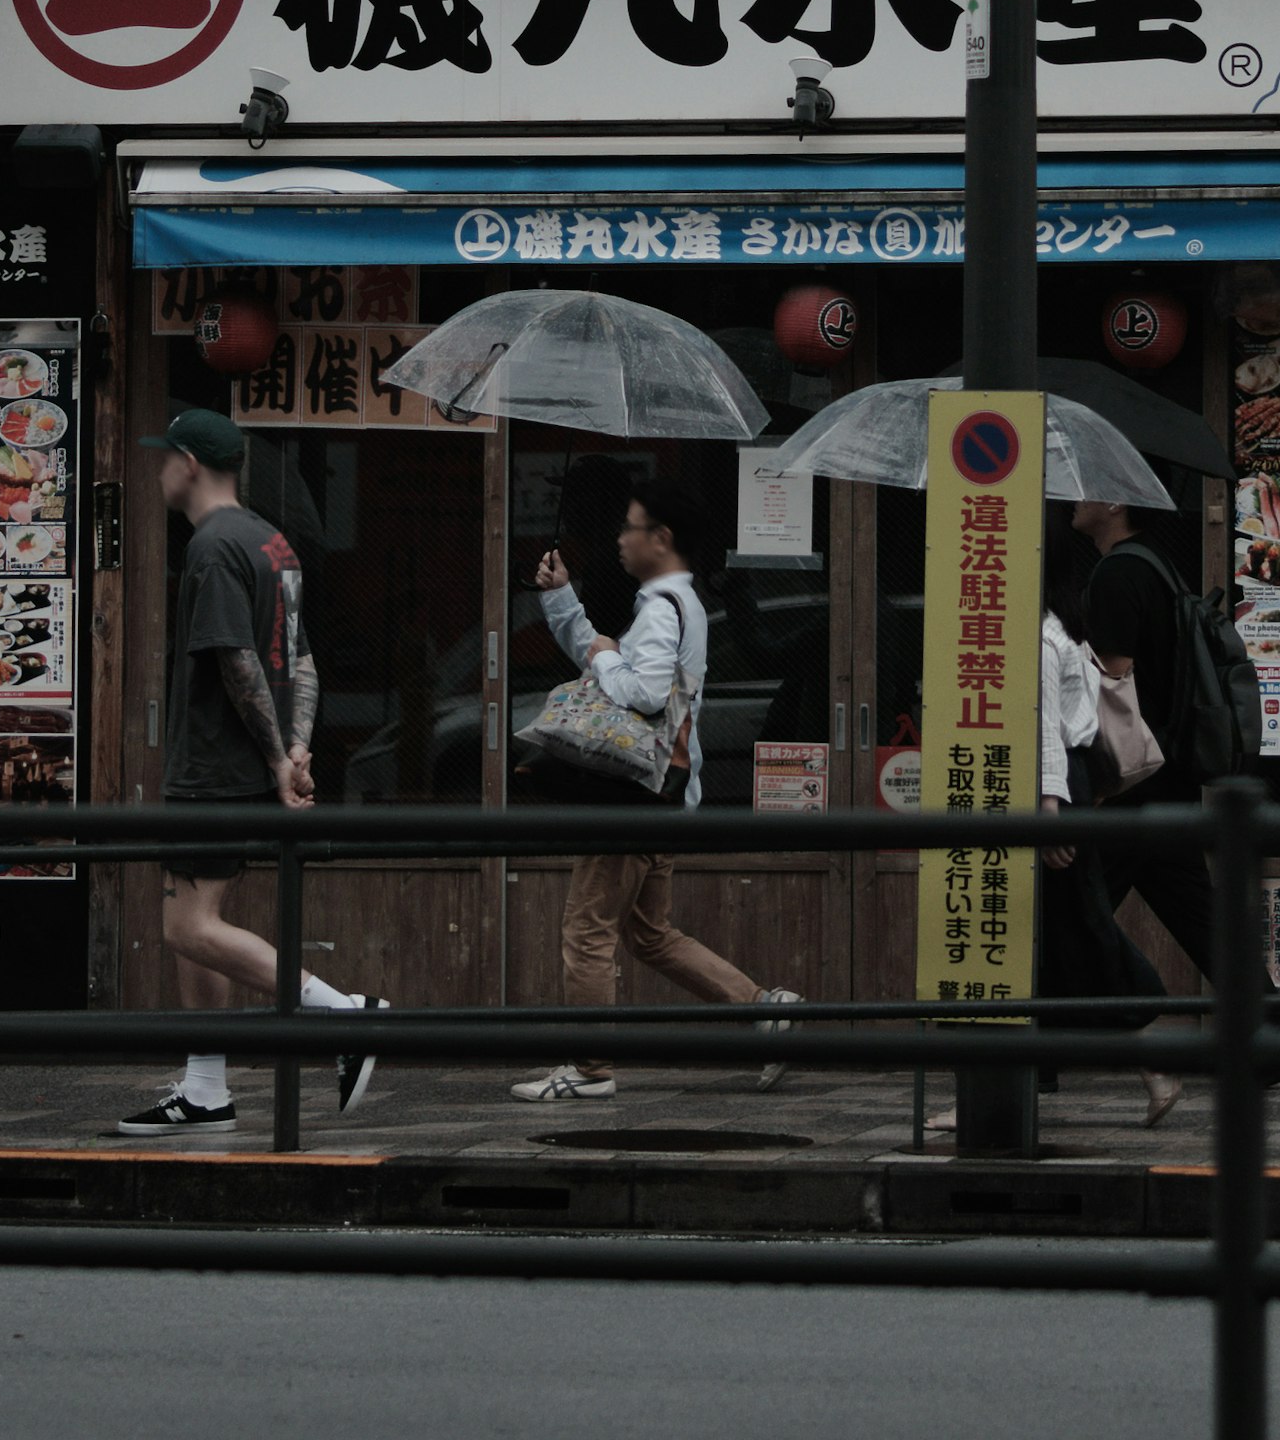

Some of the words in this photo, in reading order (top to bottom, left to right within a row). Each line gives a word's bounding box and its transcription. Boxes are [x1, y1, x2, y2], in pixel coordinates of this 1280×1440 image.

[514, 210, 721, 260] 磯丸水産
[742, 207, 1175, 259] さかな貝加ンター
[957, 495, 1008, 729] 違法駐車禁止
[759, 747, 811, 760] 監視カメラ
[945, 744, 974, 964] も取締を行います
[980, 744, 1011, 965] 運転者が乗車中で
[938, 981, 1011, 1001] 警視庁
